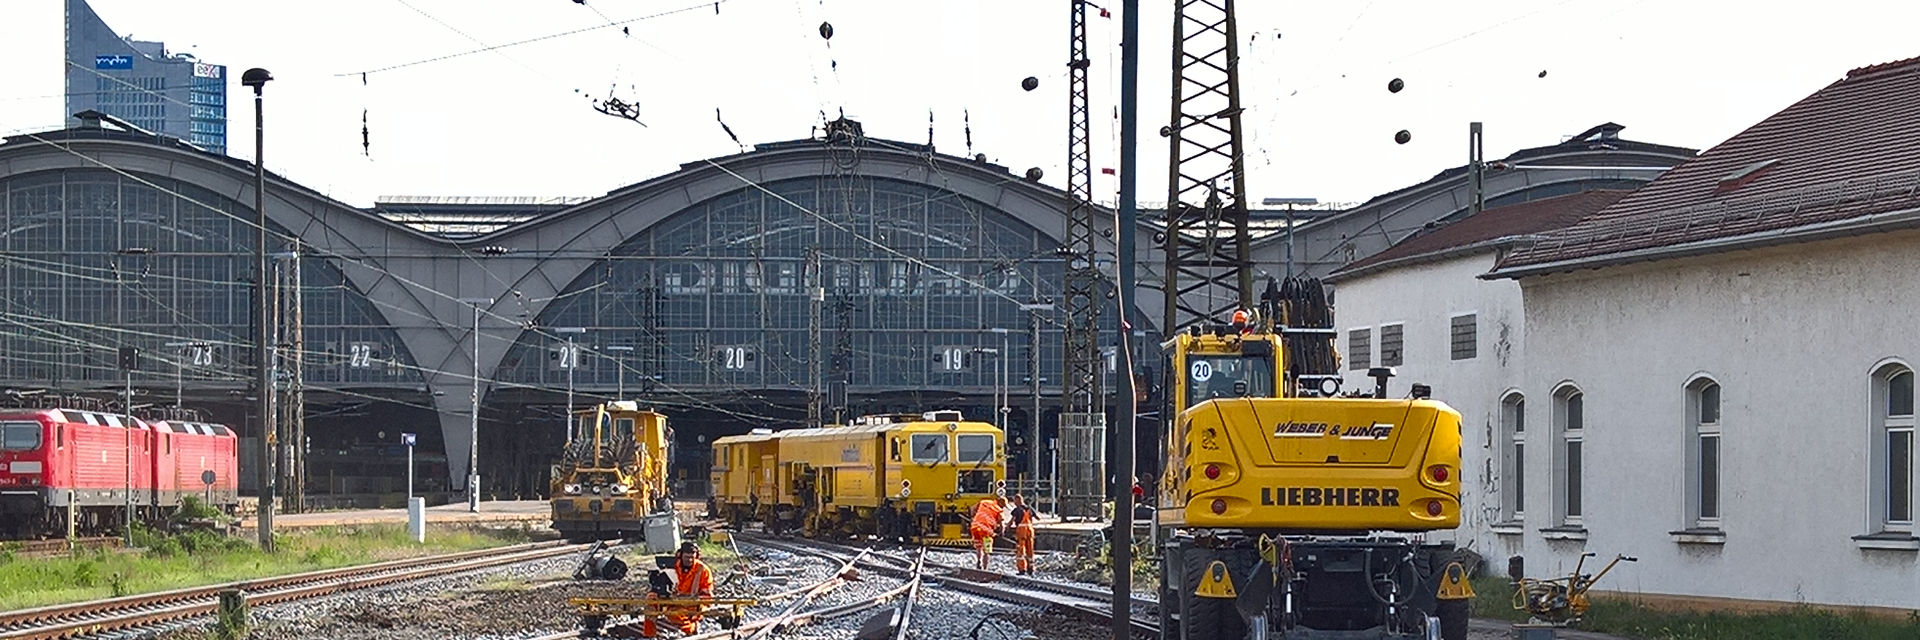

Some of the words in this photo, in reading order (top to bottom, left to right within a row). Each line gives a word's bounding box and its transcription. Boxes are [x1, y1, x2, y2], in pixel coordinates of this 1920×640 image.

[193, 345, 212, 366] 23
[351, 346, 370, 367] 22
[560, 347, 577, 368] 21
[726, 347, 745, 369] 20
[943, 348, 962, 371] 19
[1194, 363, 1210, 378] 20
[1275, 420, 1328, 434] WEBER
[1329, 424, 1341, 435] &
[1341, 420, 1394, 440] JUNGE
[1261, 487, 1400, 507] LIEBHERR
